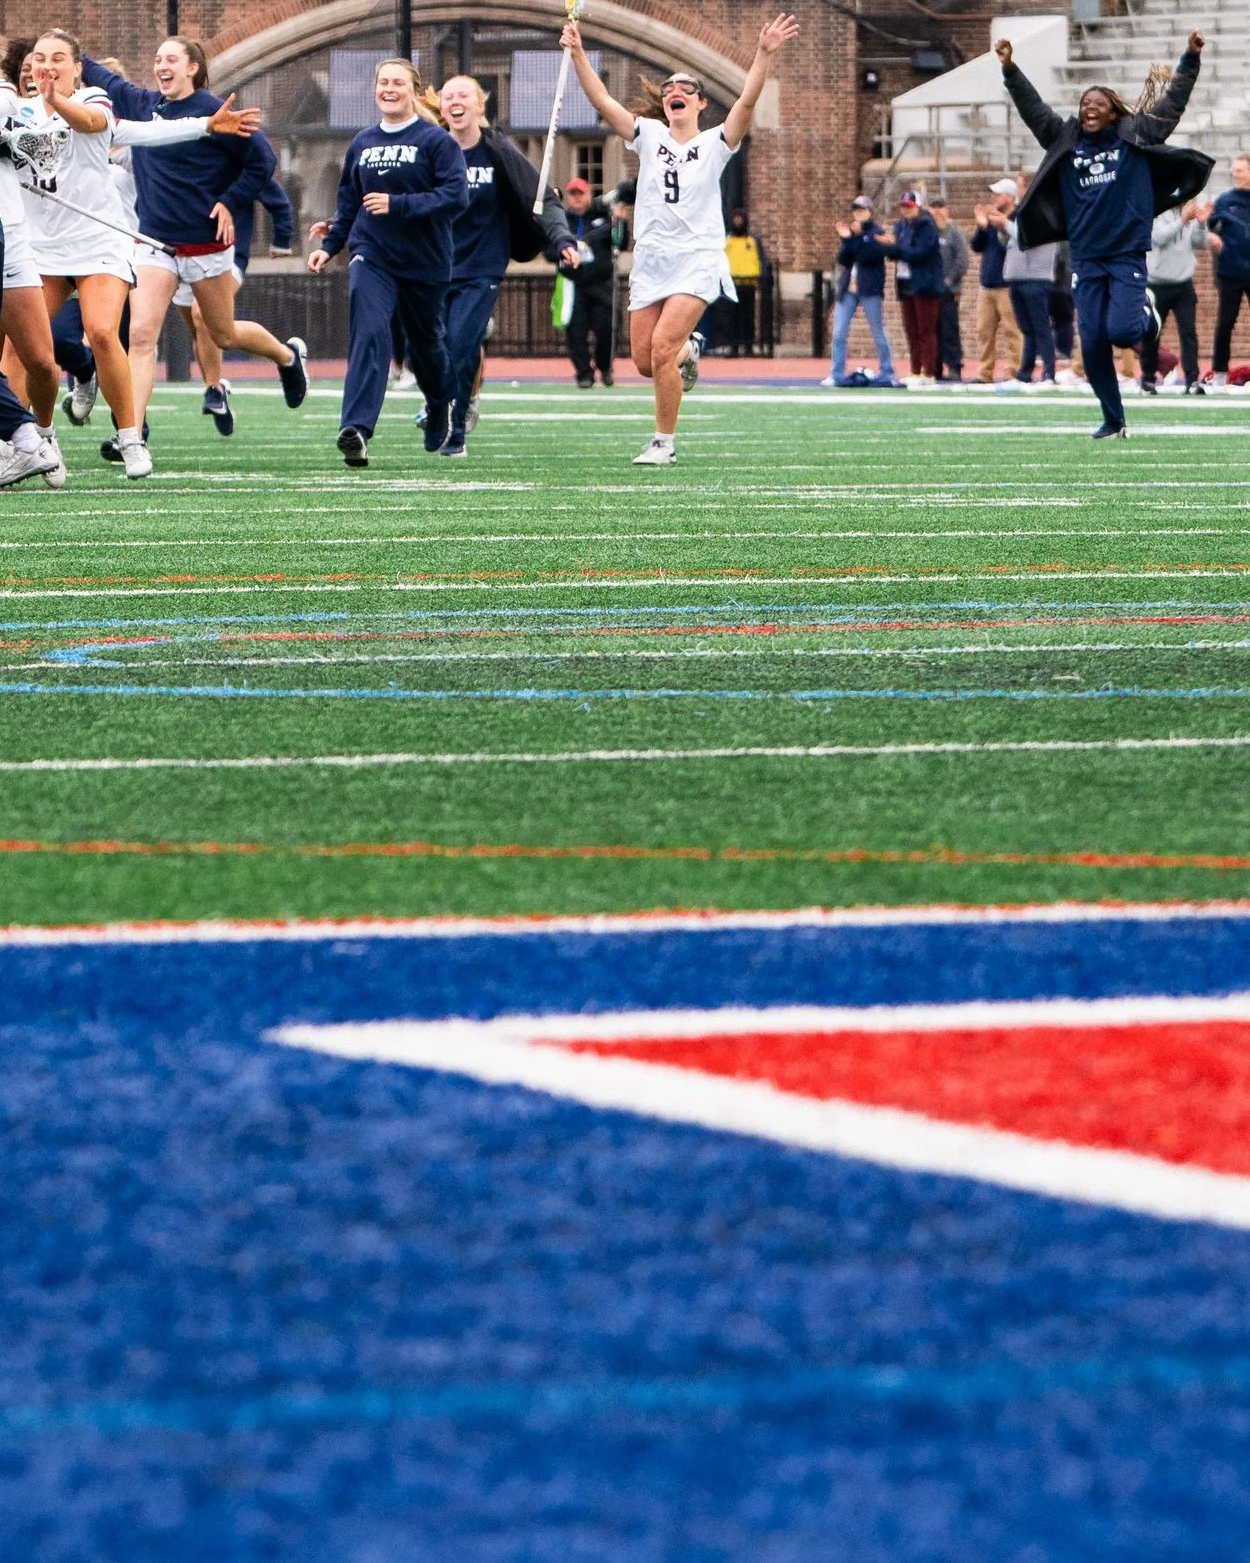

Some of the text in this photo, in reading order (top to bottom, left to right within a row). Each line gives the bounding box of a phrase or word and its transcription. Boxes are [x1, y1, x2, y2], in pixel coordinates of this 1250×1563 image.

[359, 145, 418, 166] PENN
[657, 144, 699, 166] PEN
[664, 170, 679, 204] 9
